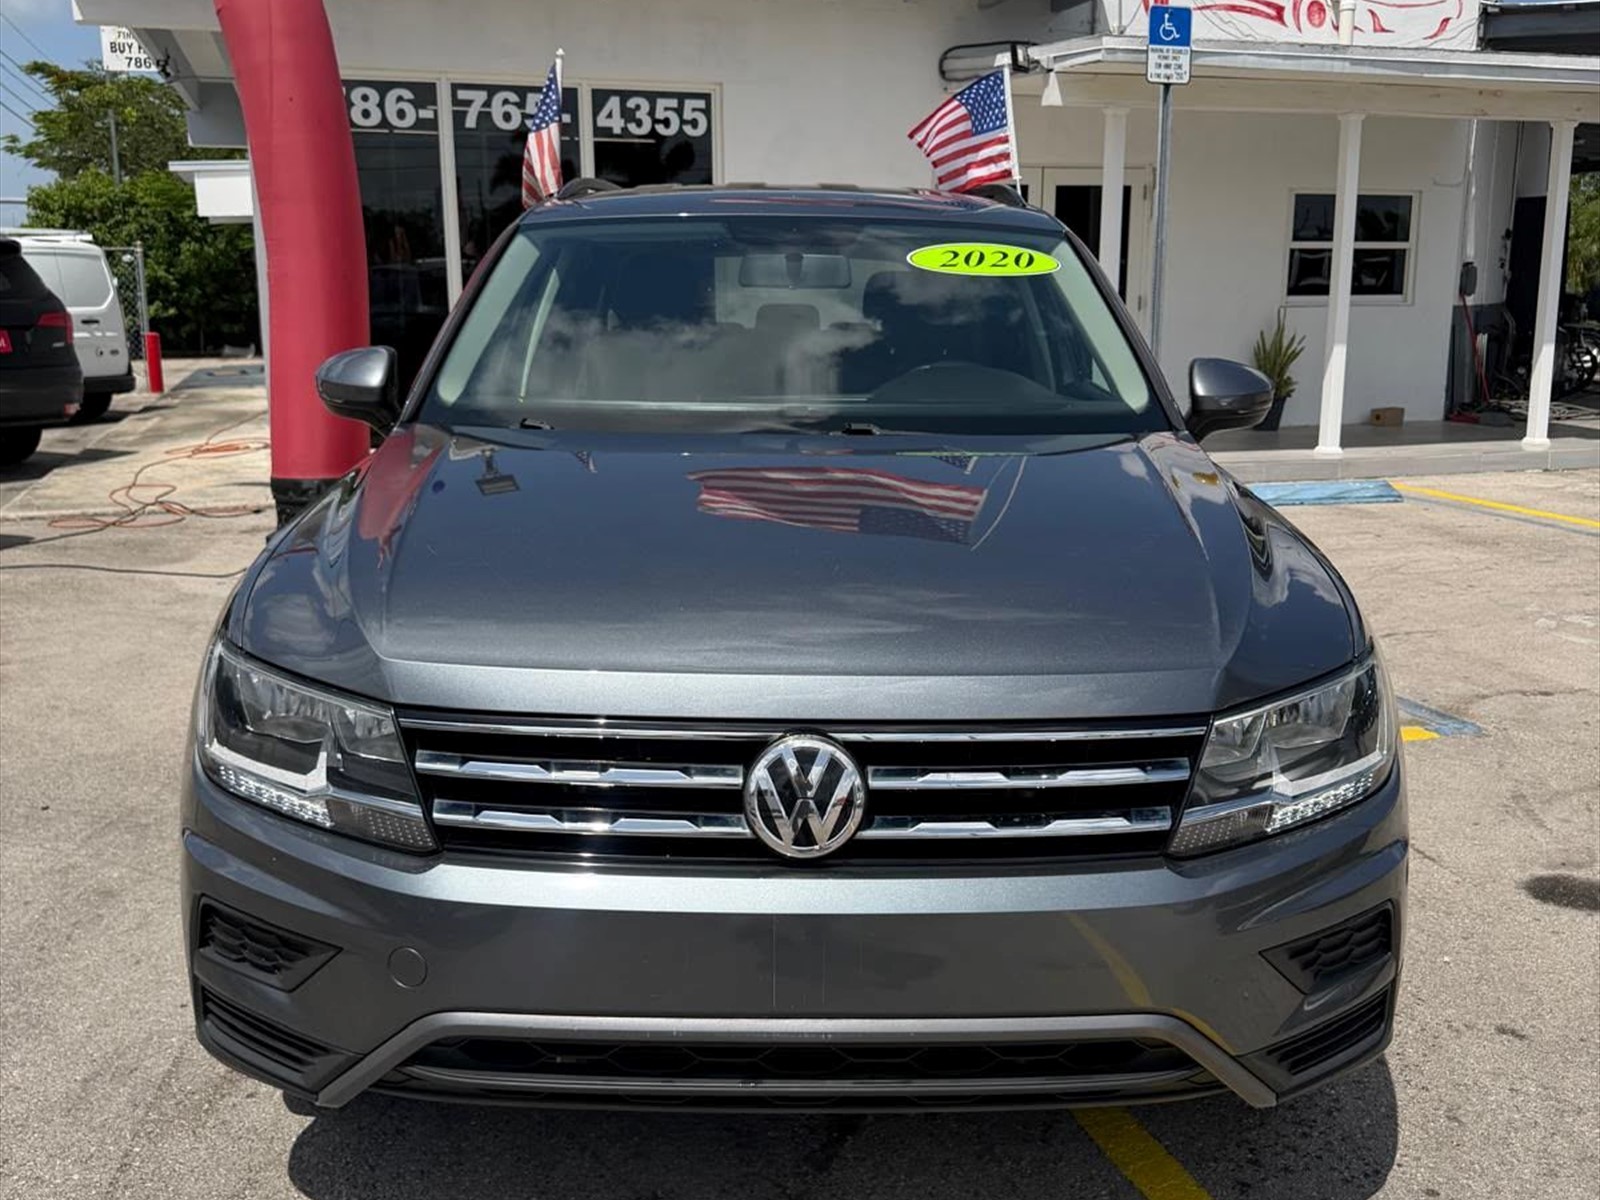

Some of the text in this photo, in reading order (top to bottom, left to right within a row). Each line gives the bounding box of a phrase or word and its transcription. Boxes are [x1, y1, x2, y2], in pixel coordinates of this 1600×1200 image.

[110, 42, 133, 54] BUY
[343, 86, 435, 129] 86-
[596, 95, 708, 137] 4355
[939, 250, 1035, 269] 2020
